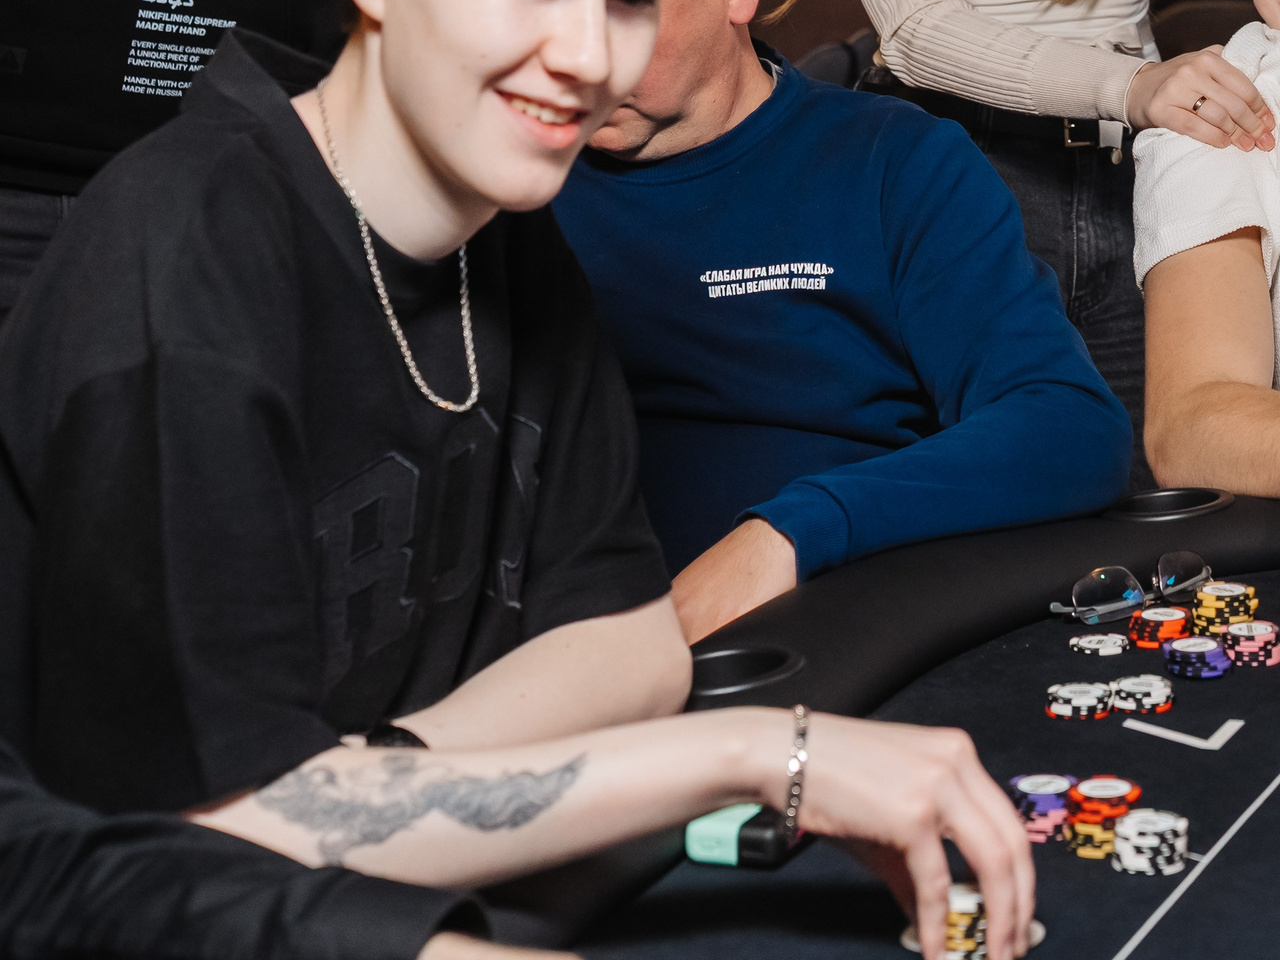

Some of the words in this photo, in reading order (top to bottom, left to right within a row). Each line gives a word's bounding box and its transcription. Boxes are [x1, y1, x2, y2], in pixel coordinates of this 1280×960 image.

[136, 20, 164, 32] MADE
[165, 24, 179, 33] BY
[179, 26, 206, 36] HAND
[132, 40, 157, 50] EVERY
[158, 43, 184, 53] SINGLE
[185, 46, 217, 56] GARMEN
[136, 50, 167, 60] UNIQUE
[167, 53, 188, 62] PIECE
[128, 58, 188, 72] FUNCTIONALITY
[124, 76, 156, 86] HANDLE
[157, 80, 177, 88] WITH
[122, 84, 146, 94] MADE
[155, 89, 182, 97] RUSSIA
[700, 269, 742, 283] «СЛАБАЯ
[744, 267, 766, 279] ИГРА
[768, 264, 789, 276] НАМ
[790, 262, 834, 276] ЧУЖДА»
[708, 282, 746, 298] ЦИТАТЫ
[746, 278, 789, 294] ВЕЛИКИХ
[791, 276, 826, 290] ЛЮДЕЙ
